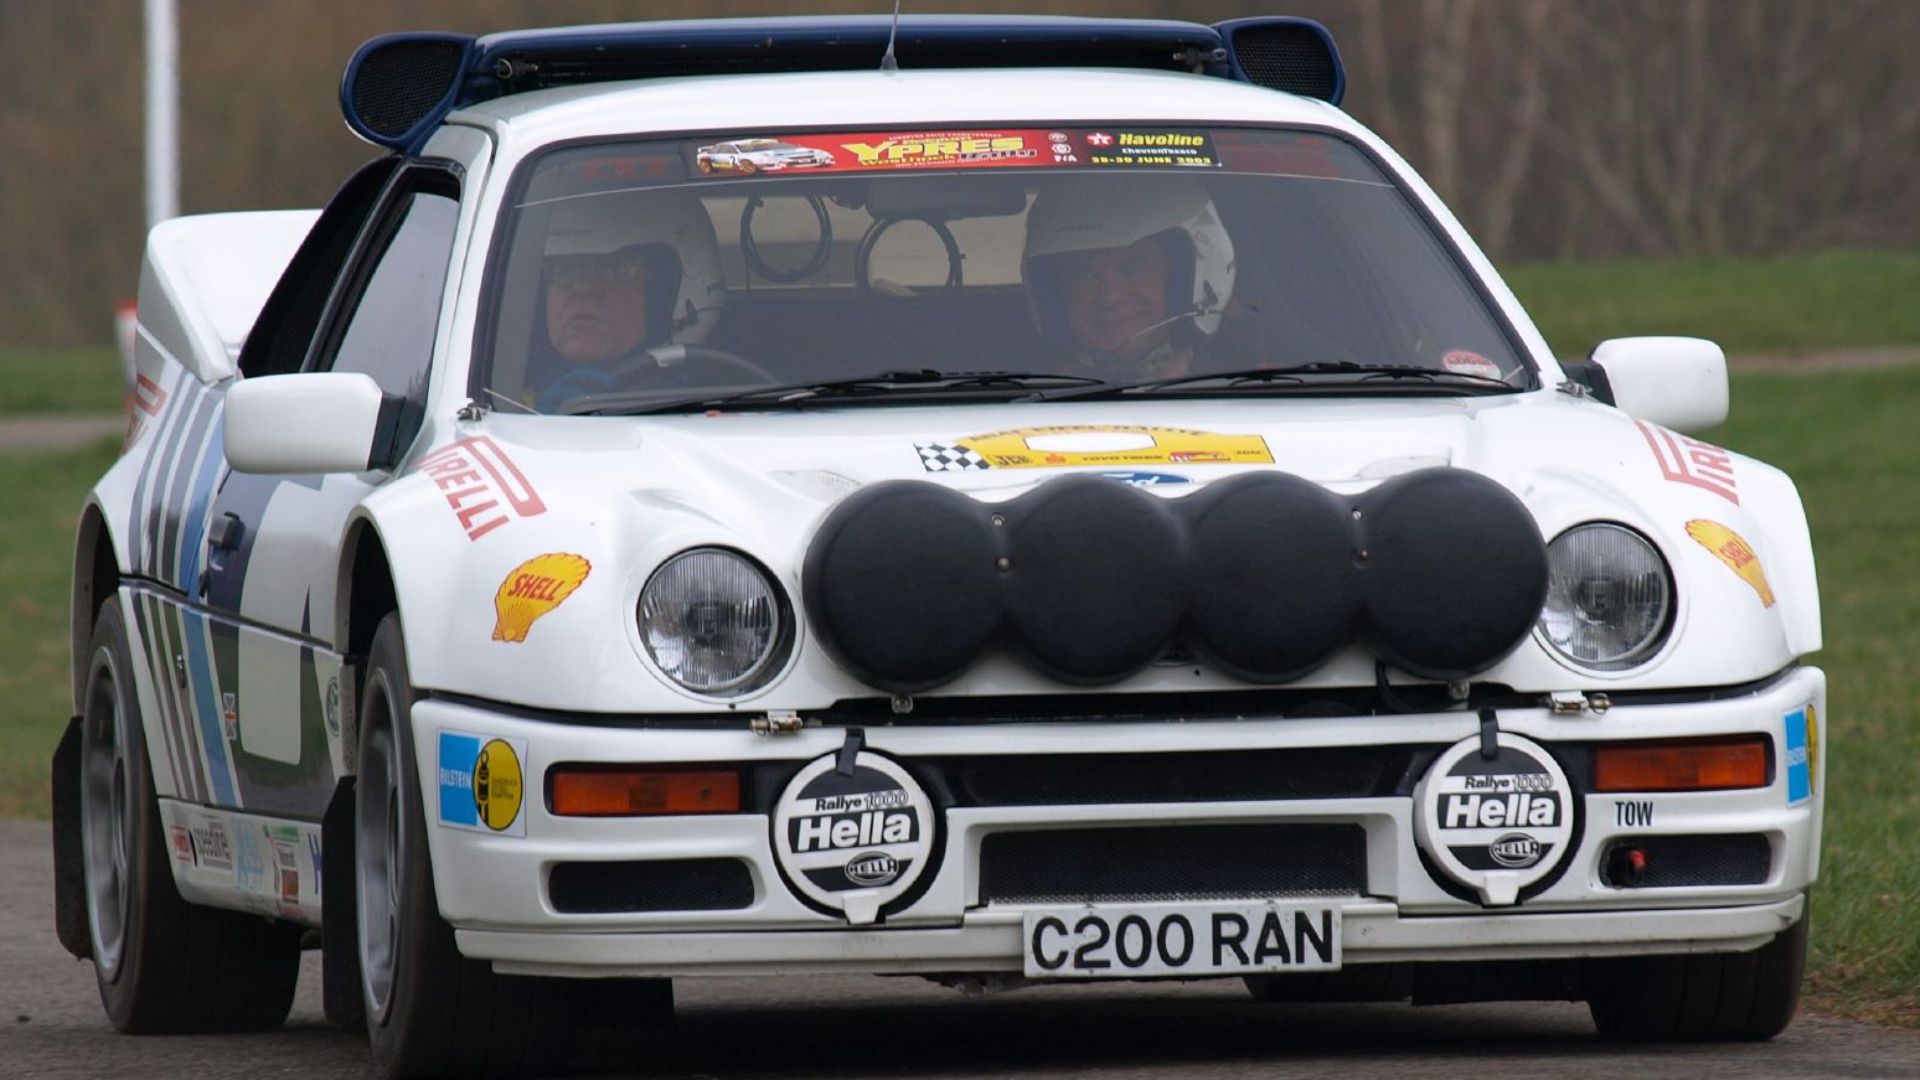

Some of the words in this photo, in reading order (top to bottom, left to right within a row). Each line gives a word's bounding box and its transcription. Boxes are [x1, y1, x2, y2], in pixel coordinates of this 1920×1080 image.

[841, 137, 1024, 161] YPRES
[1119, 133, 1204, 146] Havoline
[416, 435, 547, 542] PIRELLI
[508, 573, 565, 602] SHELL
[440, 767, 472, 790] BILSTEIN
[1465, 775, 1510, 790] Rallye
[1512, 774, 1555, 791] 1000
[815, 795, 862, 812] Rallye
[864, 790, 909, 810] 1000
[1446, 793, 1555, 828] Hella
[1615, 801, 1653, 826] TOW
[797, 811, 912, 853] Hella
[849, 857, 898, 874] HELLA
[1032, 914, 1194, 970] C200
[1211, 909, 1333, 967] RAN
